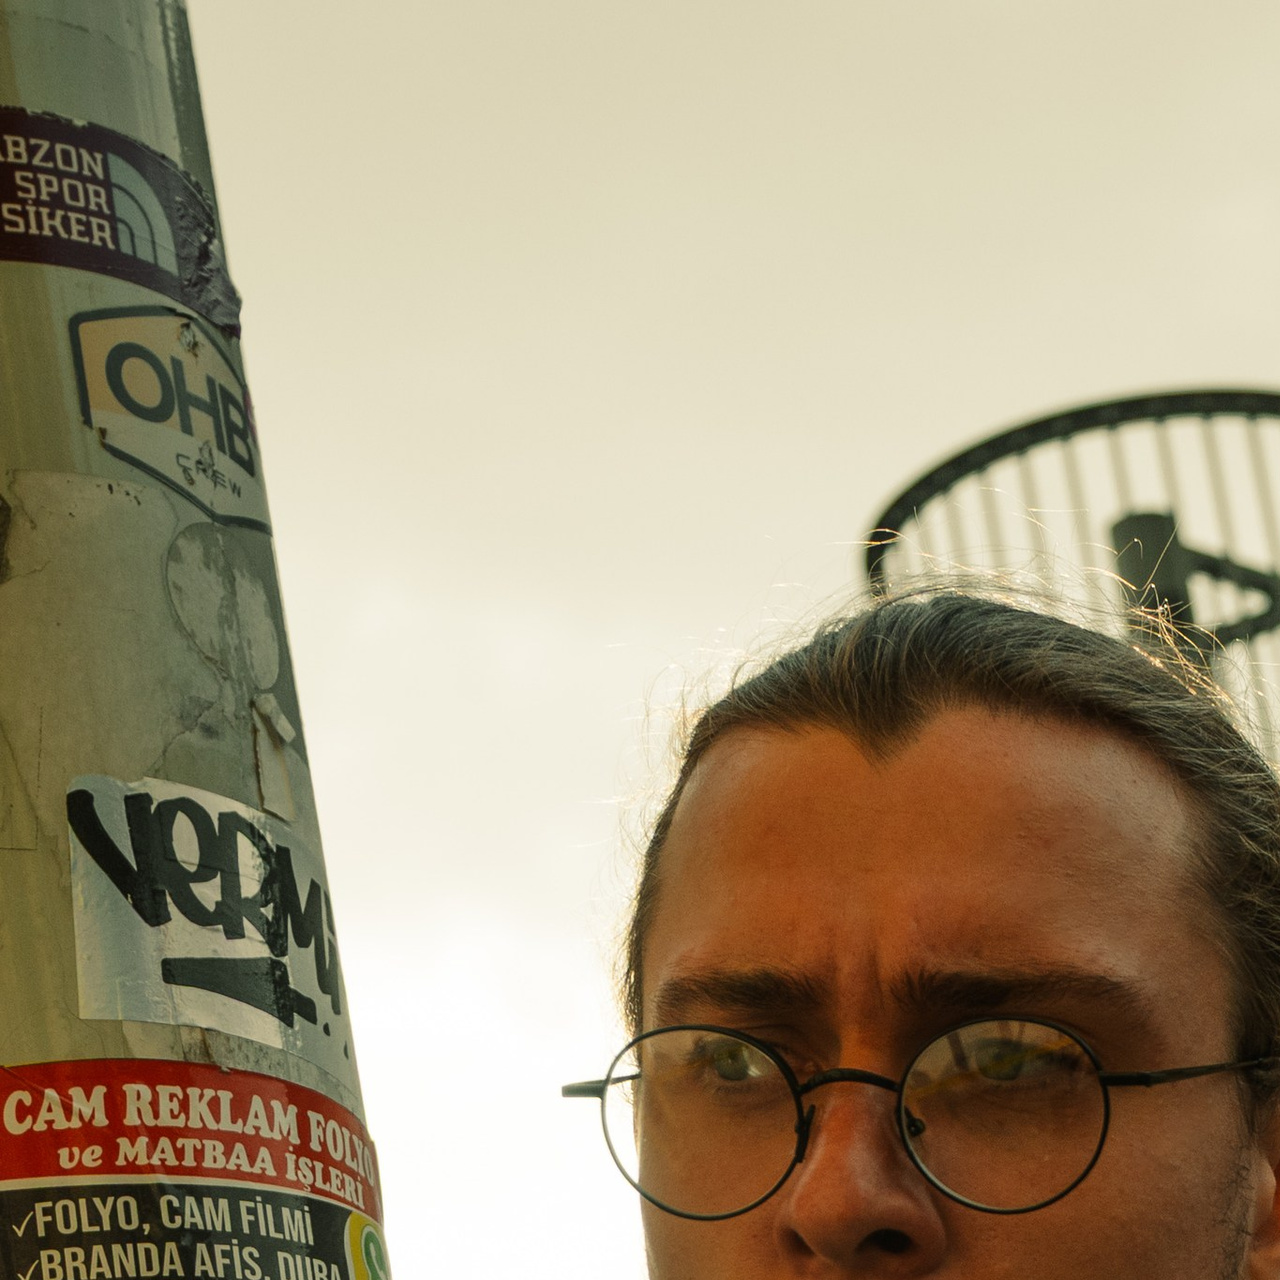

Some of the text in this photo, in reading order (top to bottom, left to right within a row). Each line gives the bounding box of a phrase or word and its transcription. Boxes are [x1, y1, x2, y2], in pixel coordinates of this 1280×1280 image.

[15, 171, 111, 214] SPOR
[2, 199, 116, 250] SİKER
[105, 341, 256, 478] OHB
[3, 1083, 375, 1188] CAM REKLAM FOLYO
[58, 1136, 365, 1210] ve MATBAA İŞLERİ
[35, 1194, 315, 1246] FOLYO, CAM FİLMİ
